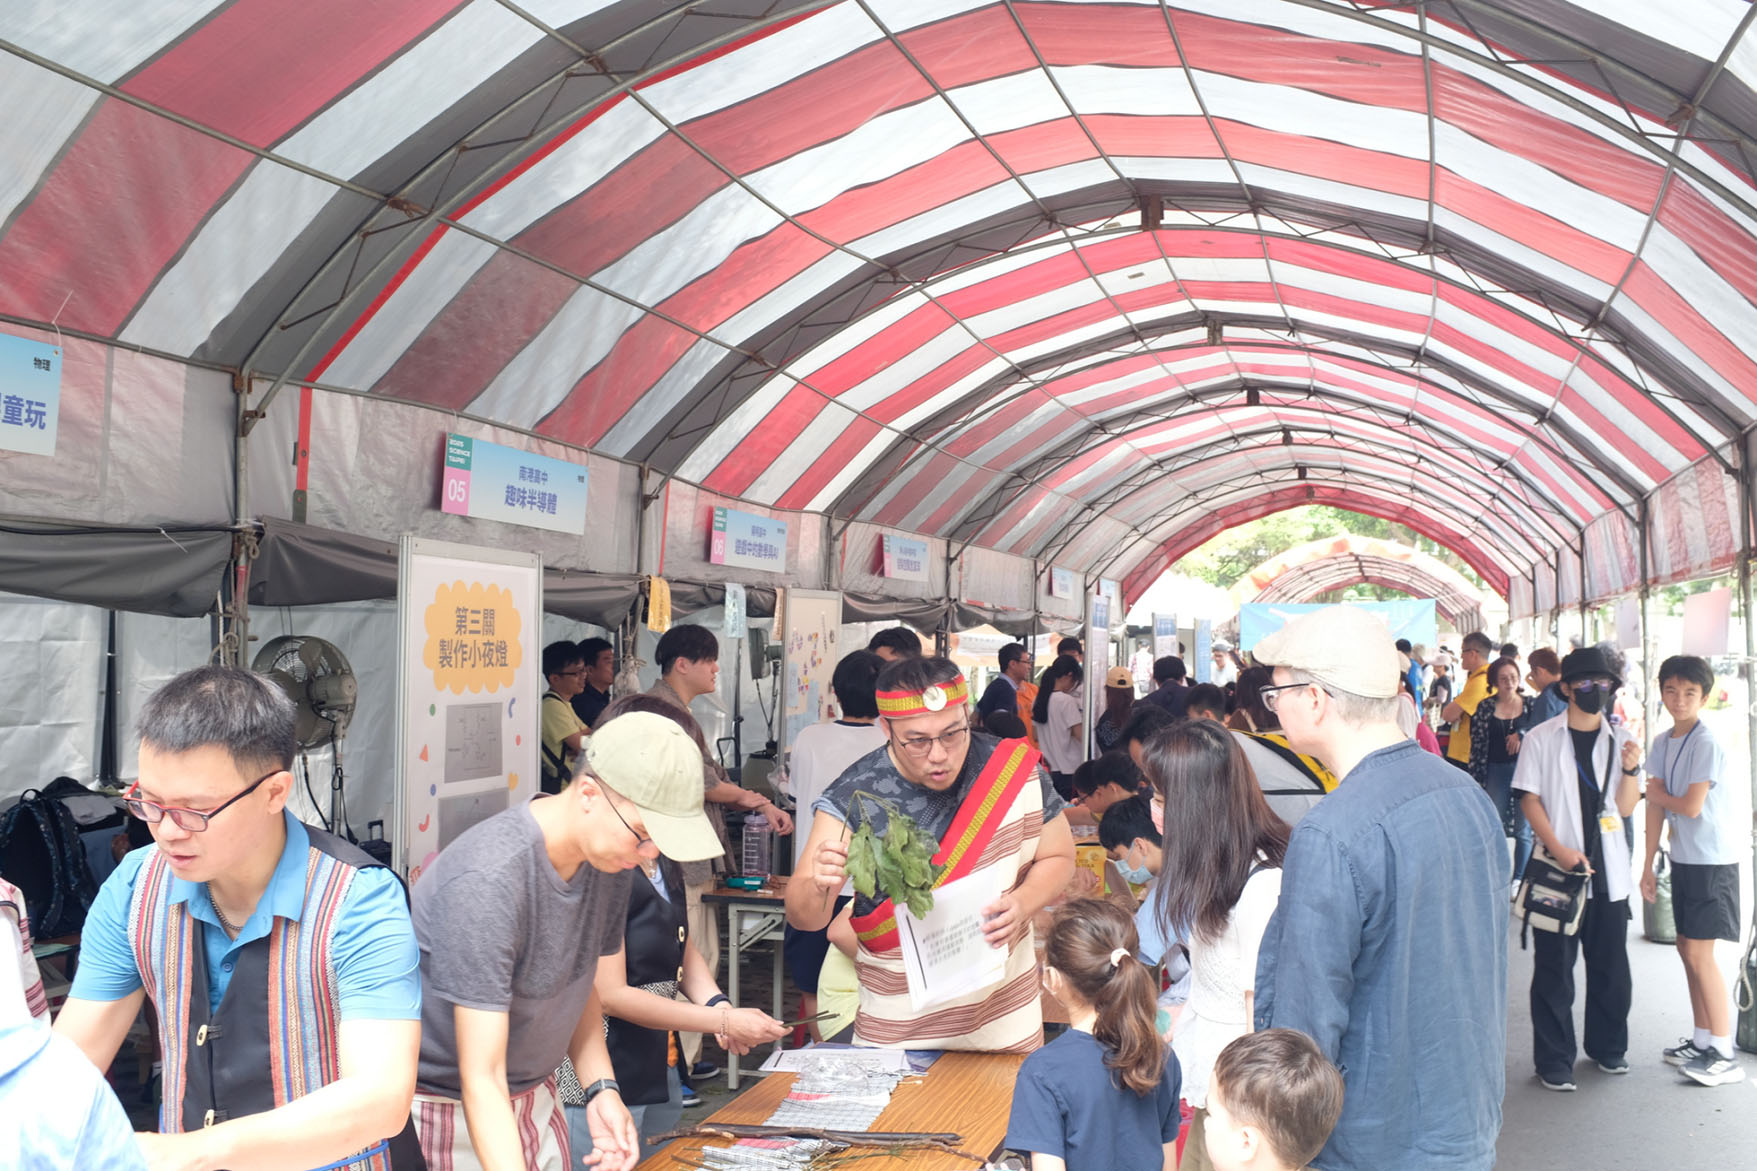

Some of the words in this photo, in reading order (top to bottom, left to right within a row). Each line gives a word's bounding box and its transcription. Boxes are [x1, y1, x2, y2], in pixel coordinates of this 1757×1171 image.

[34, 357, 50, 372] 物理
[0, 392, 46, 430] 童玩
[449, 479, 466, 502] 05
[504, 484, 557, 515] 趣味半導體
[455, 607, 495, 635] 第三關
[439, 639, 508, 668] 製作小夜燈
